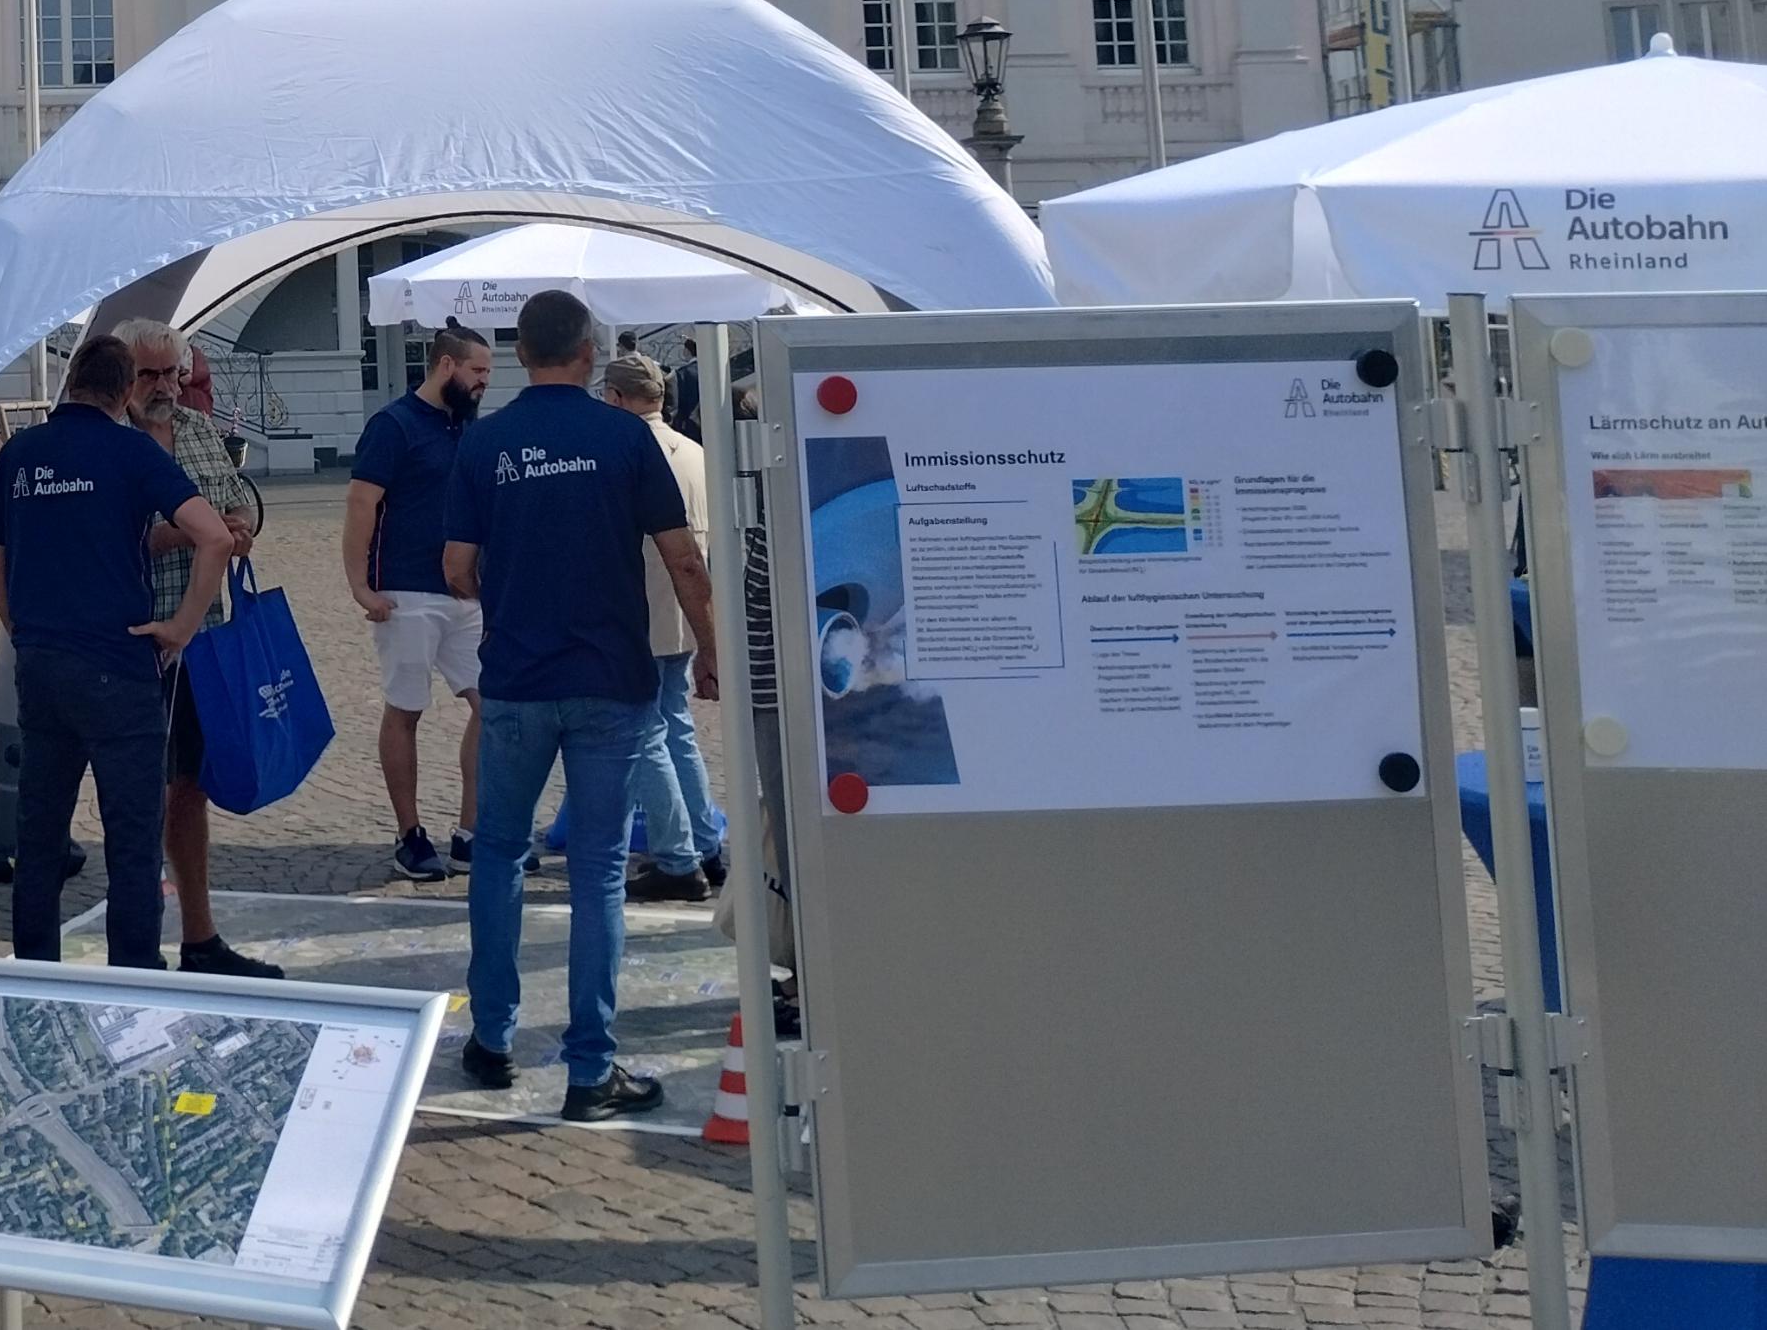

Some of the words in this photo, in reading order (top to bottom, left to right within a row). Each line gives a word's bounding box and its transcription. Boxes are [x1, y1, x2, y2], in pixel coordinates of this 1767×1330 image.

[1565, 187, 1616, 211] Die
[1567, 214, 1729, 241] Autobahn
[1569, 252, 1688, 270] Rheinland
[482, 281, 497, 291] Die
[481, 292, 529, 302] Autobahn
[1321, 378, 1341, 390] Die
[1323, 392, 1384, 403] Autobahn
[1589, 414, 1704, 430] Lärmschutz
[1708, 418, 1731, 430] an
[521, 446, 546, 462] Die
[904, 449, 1067, 467] Immissionsschutz
[35, 466, 54, 480] Die
[525, 455, 597, 478] Autobahn
[34, 477, 94, 495] Autobahn
[906, 482, 976, 492] Luftschadstoffe
[908, 517, 988, 527] Aufgabenstellung
